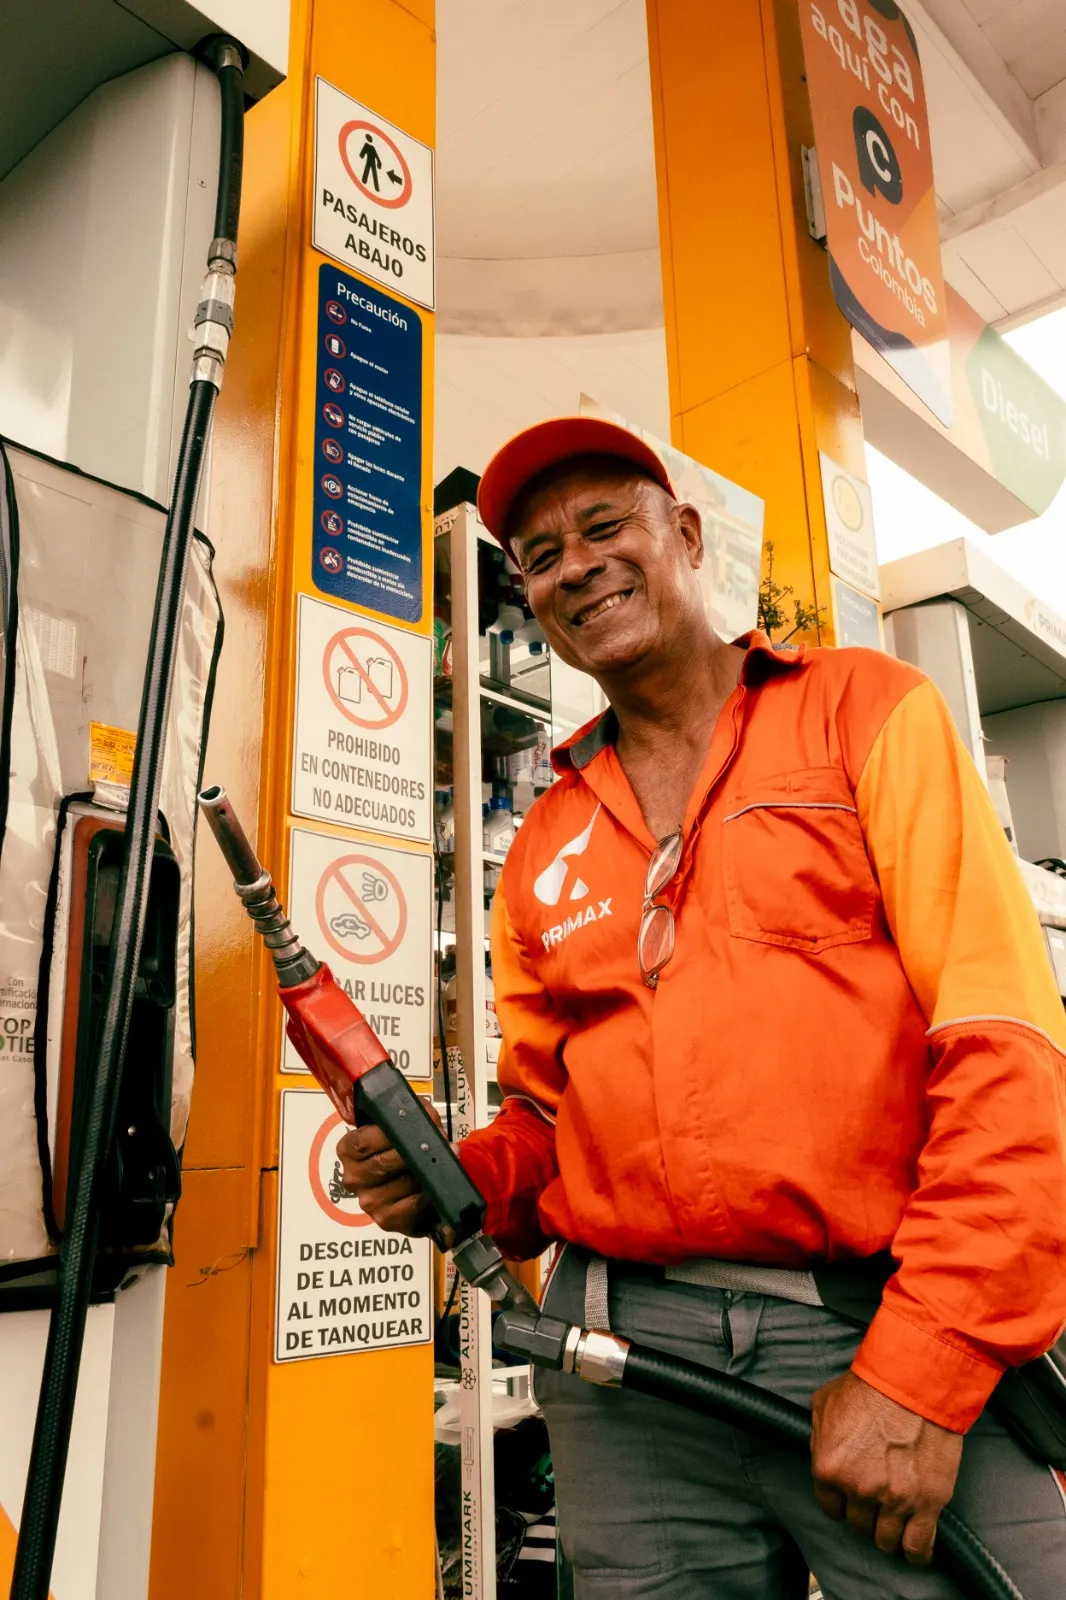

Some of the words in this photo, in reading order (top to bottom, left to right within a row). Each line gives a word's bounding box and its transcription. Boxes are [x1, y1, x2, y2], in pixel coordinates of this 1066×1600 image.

[878, 82, 920, 150] con
[323, 188, 427, 263] PASAJEROS
[831, 161, 938, 316] Puntos
[344, 233, 403, 278] ABAJO
[858, 236, 926, 329] Colombia
[337, 282, 408, 331] Precaución
[981, 367, 1049, 461] Diesel
[327, 729, 400, 766] PROHIBIDO
[301, 752, 318, 775] EN
[322, 758, 425, 801] CONTENEDORES
[313, 787, 331, 809] NO
[335, 793, 416, 828] ADECUADOS
[541, 897, 613, 953] PRIMAX
[335, 977, 366, 1001] AR
[370, 981, 425, 1007] LUCES
[361, 1013, 401, 1037] NTE
[299, 1237, 413, 1262] DESCIENDA
[297, 1271, 324, 1291] DE
[329, 1269, 353, 1288] LA
[358, 1264, 414, 1285] MOTO
[287, 1301, 313, 1321] AL
[318, 1290, 421, 1318] MOMENTO
[285, 1328, 314, 1351] DE
[318, 1317, 423, 1346] TANQUEAR
